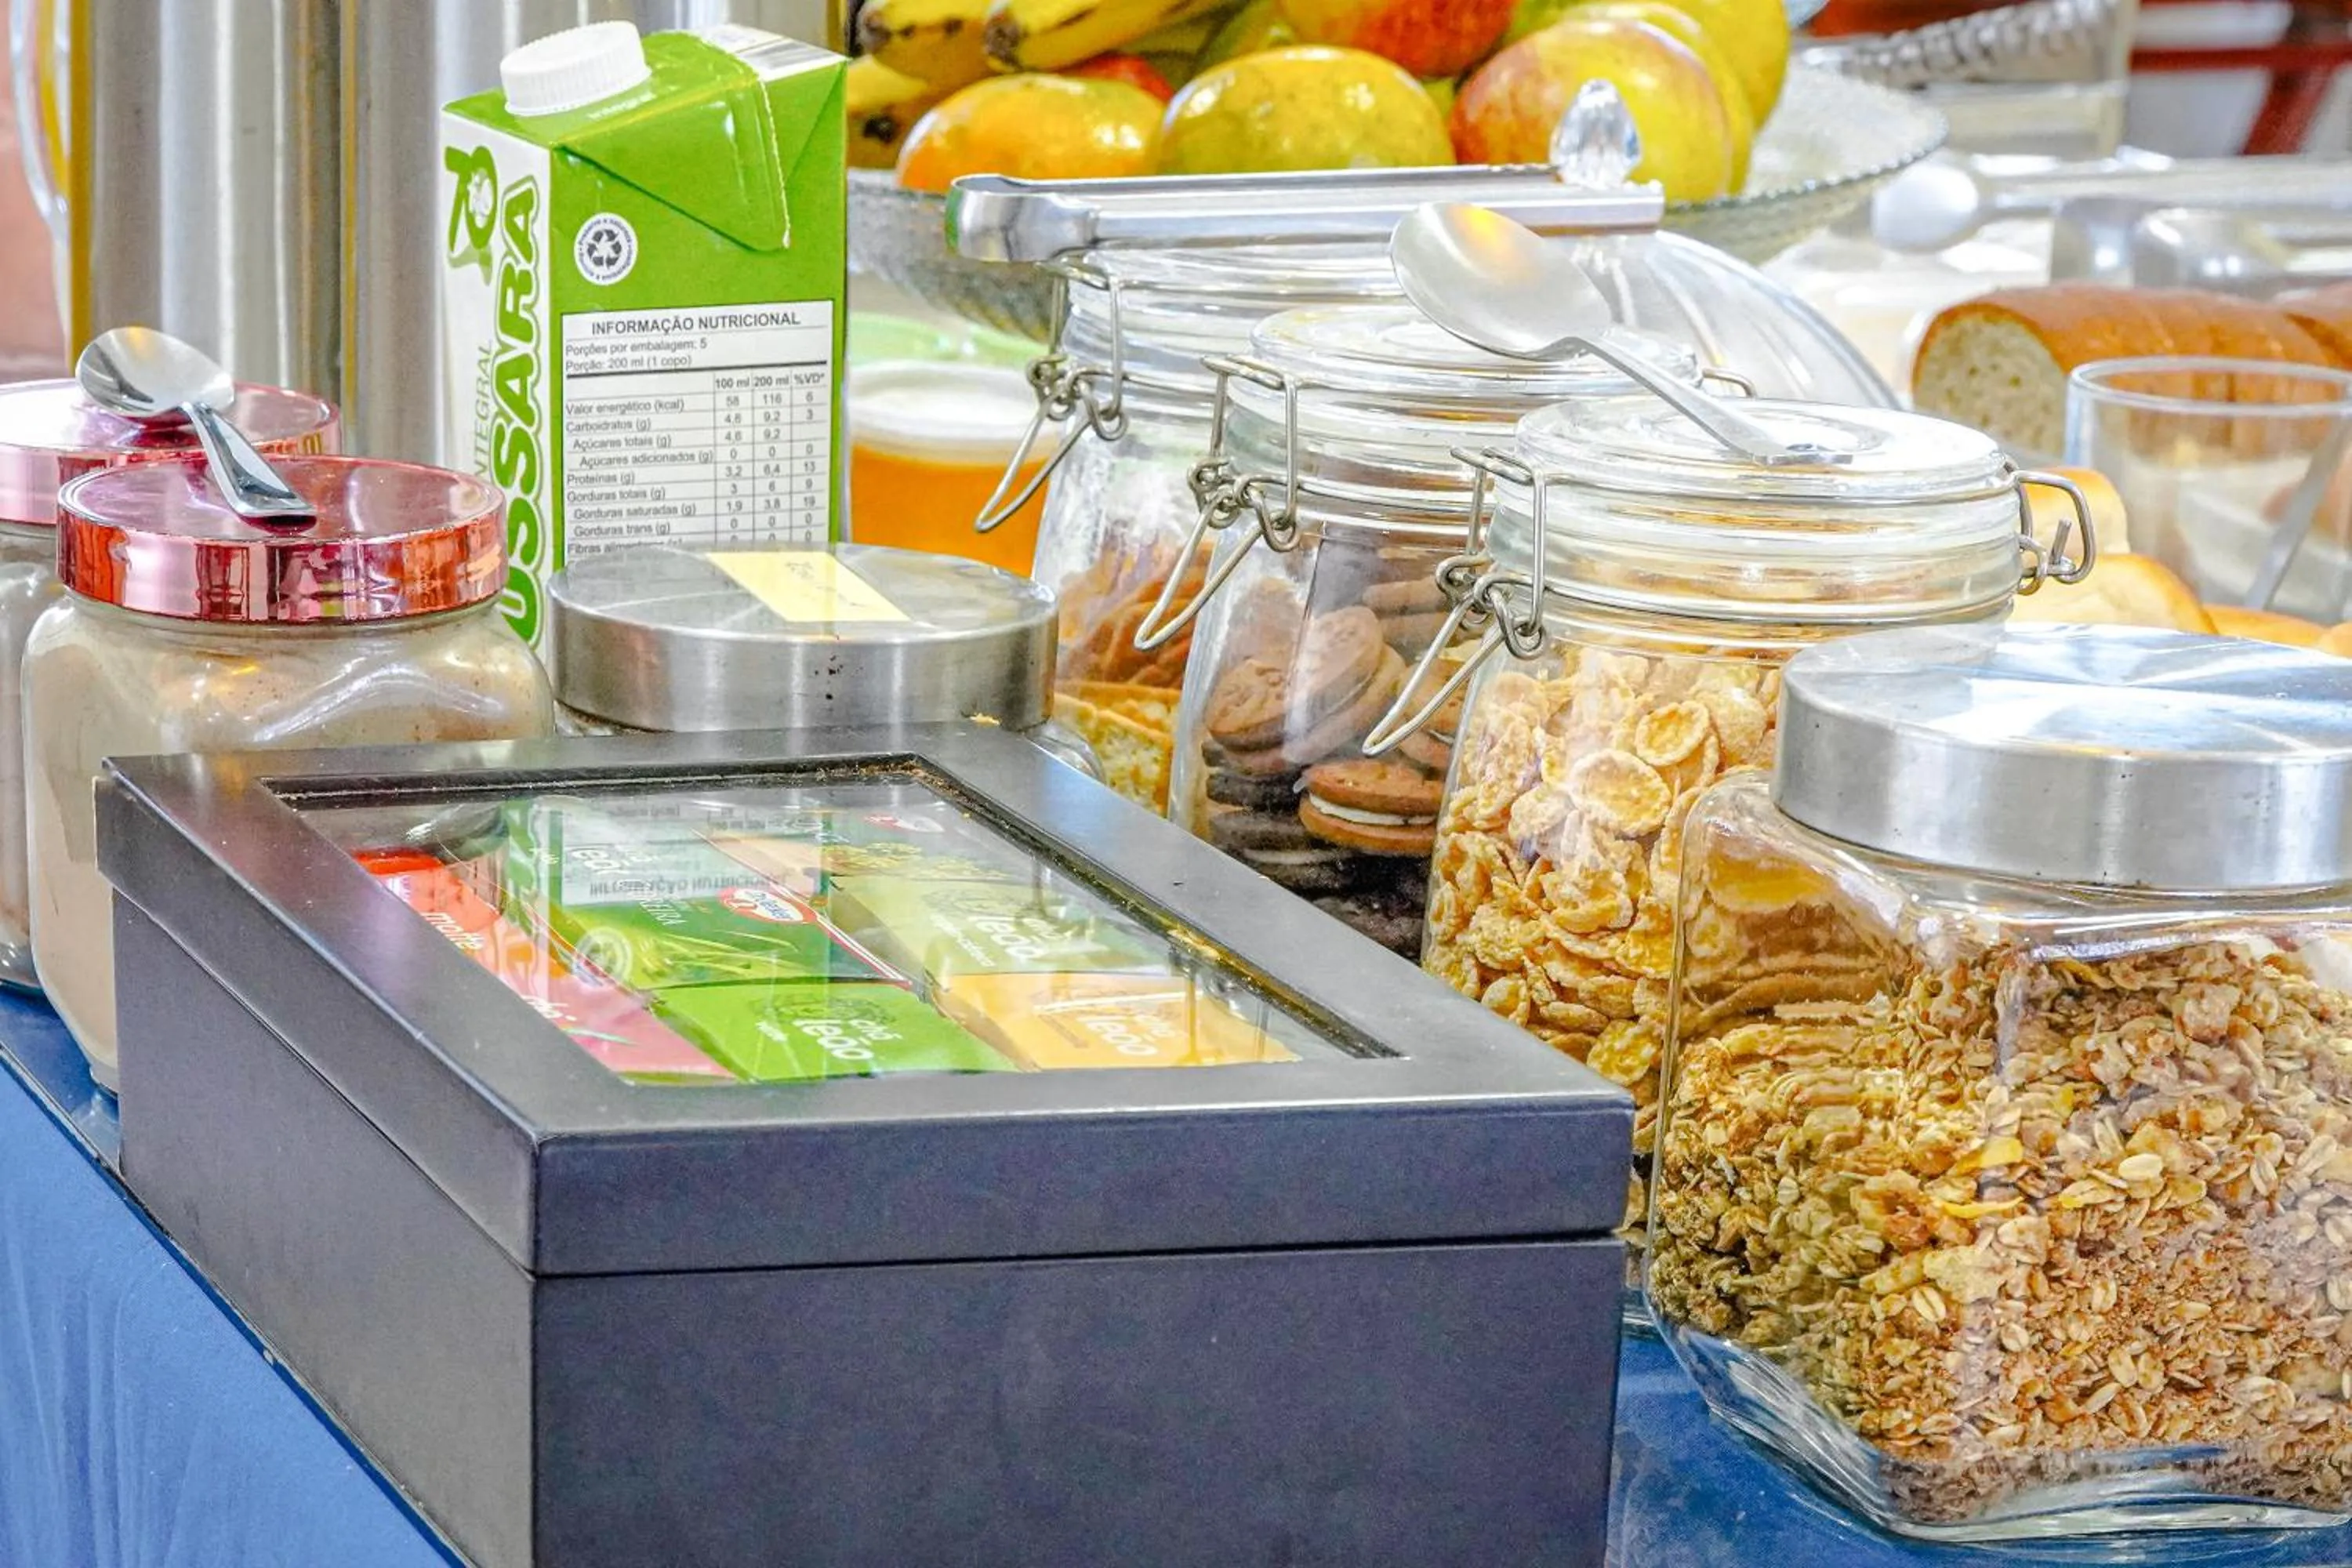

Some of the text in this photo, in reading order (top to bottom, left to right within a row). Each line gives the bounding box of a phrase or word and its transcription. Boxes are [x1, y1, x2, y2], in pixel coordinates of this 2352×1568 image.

[592, 312, 800, 336] INFORMAÇÃO NUTRICIONAL
[566, 338, 707, 357] Porções por embalagem: 5
[566, 355, 692, 372] Porção: 200 ml (1 copo)
[715, 376, 750, 389] 100 ml
[753, 375, 789, 387] 200 ml
[474, 339, 492, 476] NTEGRAL
[489, 177, 539, 646] USSARA
[566, 399, 684, 415] Valor energético (kcal)
[806, 408, 813, 420] 3
[636, 418, 651, 431] (g)
[624, 437, 653, 447] totais
[656, 434, 672, 448] (g)
[730, 448, 737, 459] 0
[768, 445, 775, 457] 0
[806, 444, 813, 455] 0
[632, 452, 695, 465] adicionados
[699, 450, 713, 463] (g)
[620, 471, 635, 485] (g)
[567, 487, 666, 503] Gorduras totais (g)
[731, 483, 738, 495] 3
[574, 503, 696, 520] Gorduras saturadas (g)
[805, 513, 812, 524] 0
[730, 517, 738, 529] 0
[768, 516, 775, 527] 0
[574, 521, 670, 537] Gorduras trans (g)
